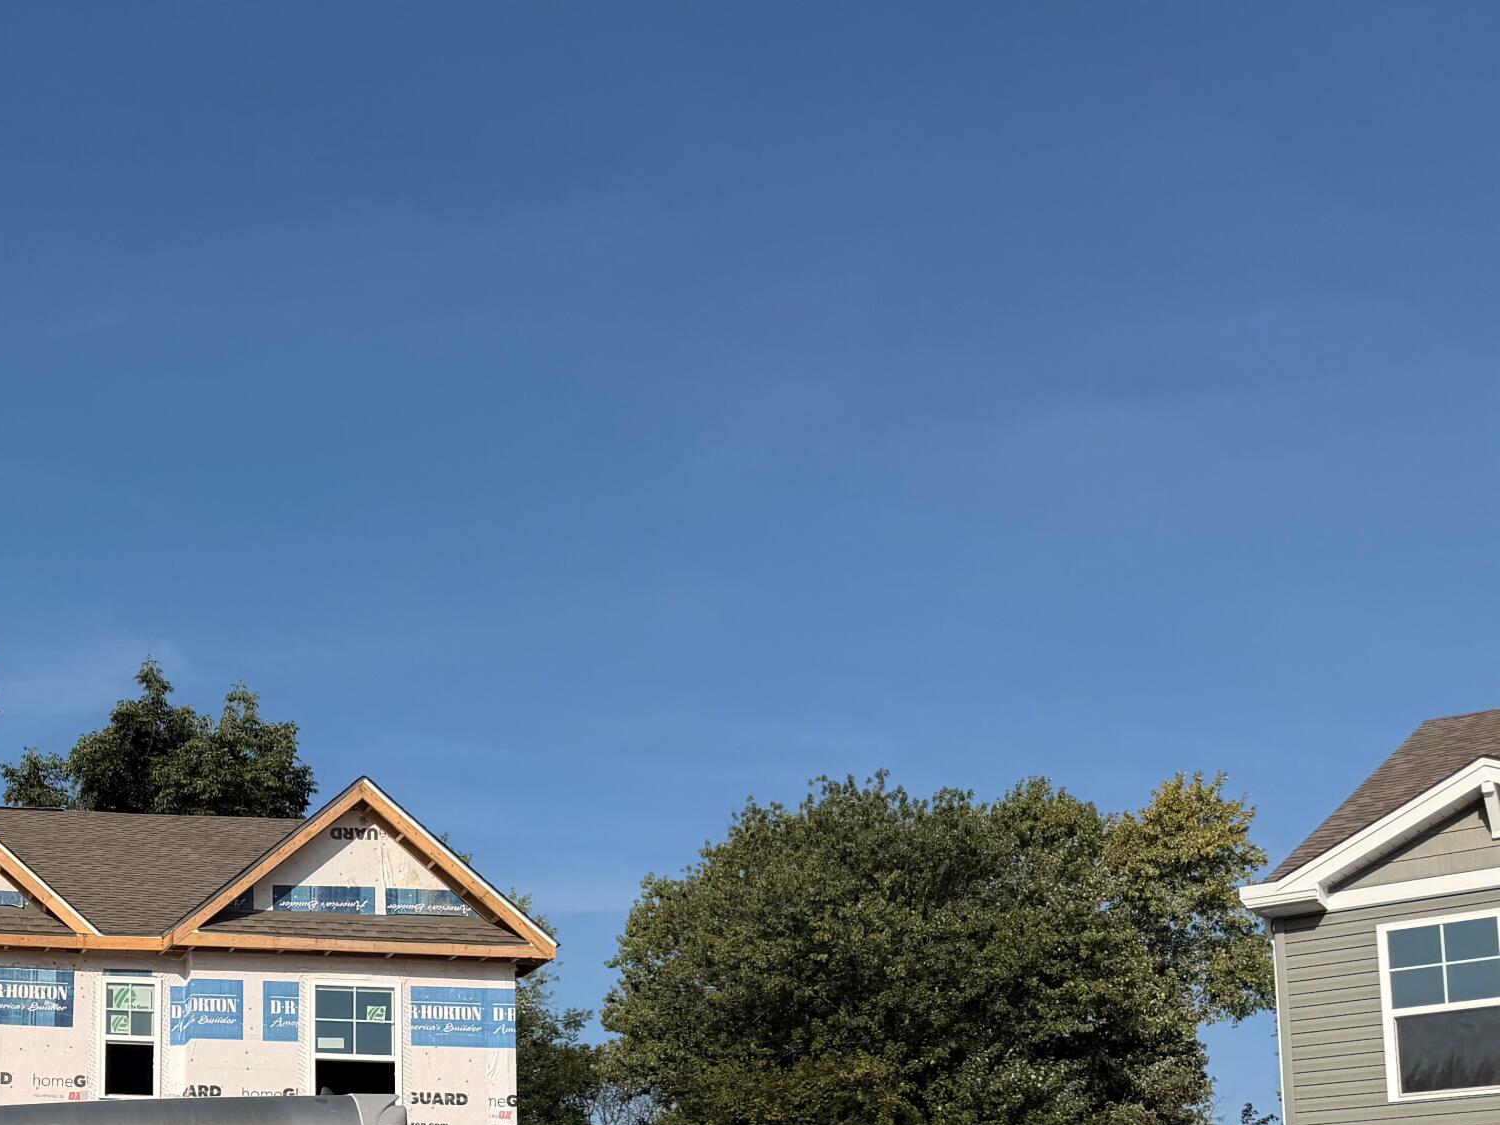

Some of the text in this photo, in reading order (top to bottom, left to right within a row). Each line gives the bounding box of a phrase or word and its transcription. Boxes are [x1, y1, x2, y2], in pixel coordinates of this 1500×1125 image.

[443, 1023, 482, 1034] Builder
[32, 1073, 88, 1088] homeG
[411, 1092, 468, 1106] GUARD
